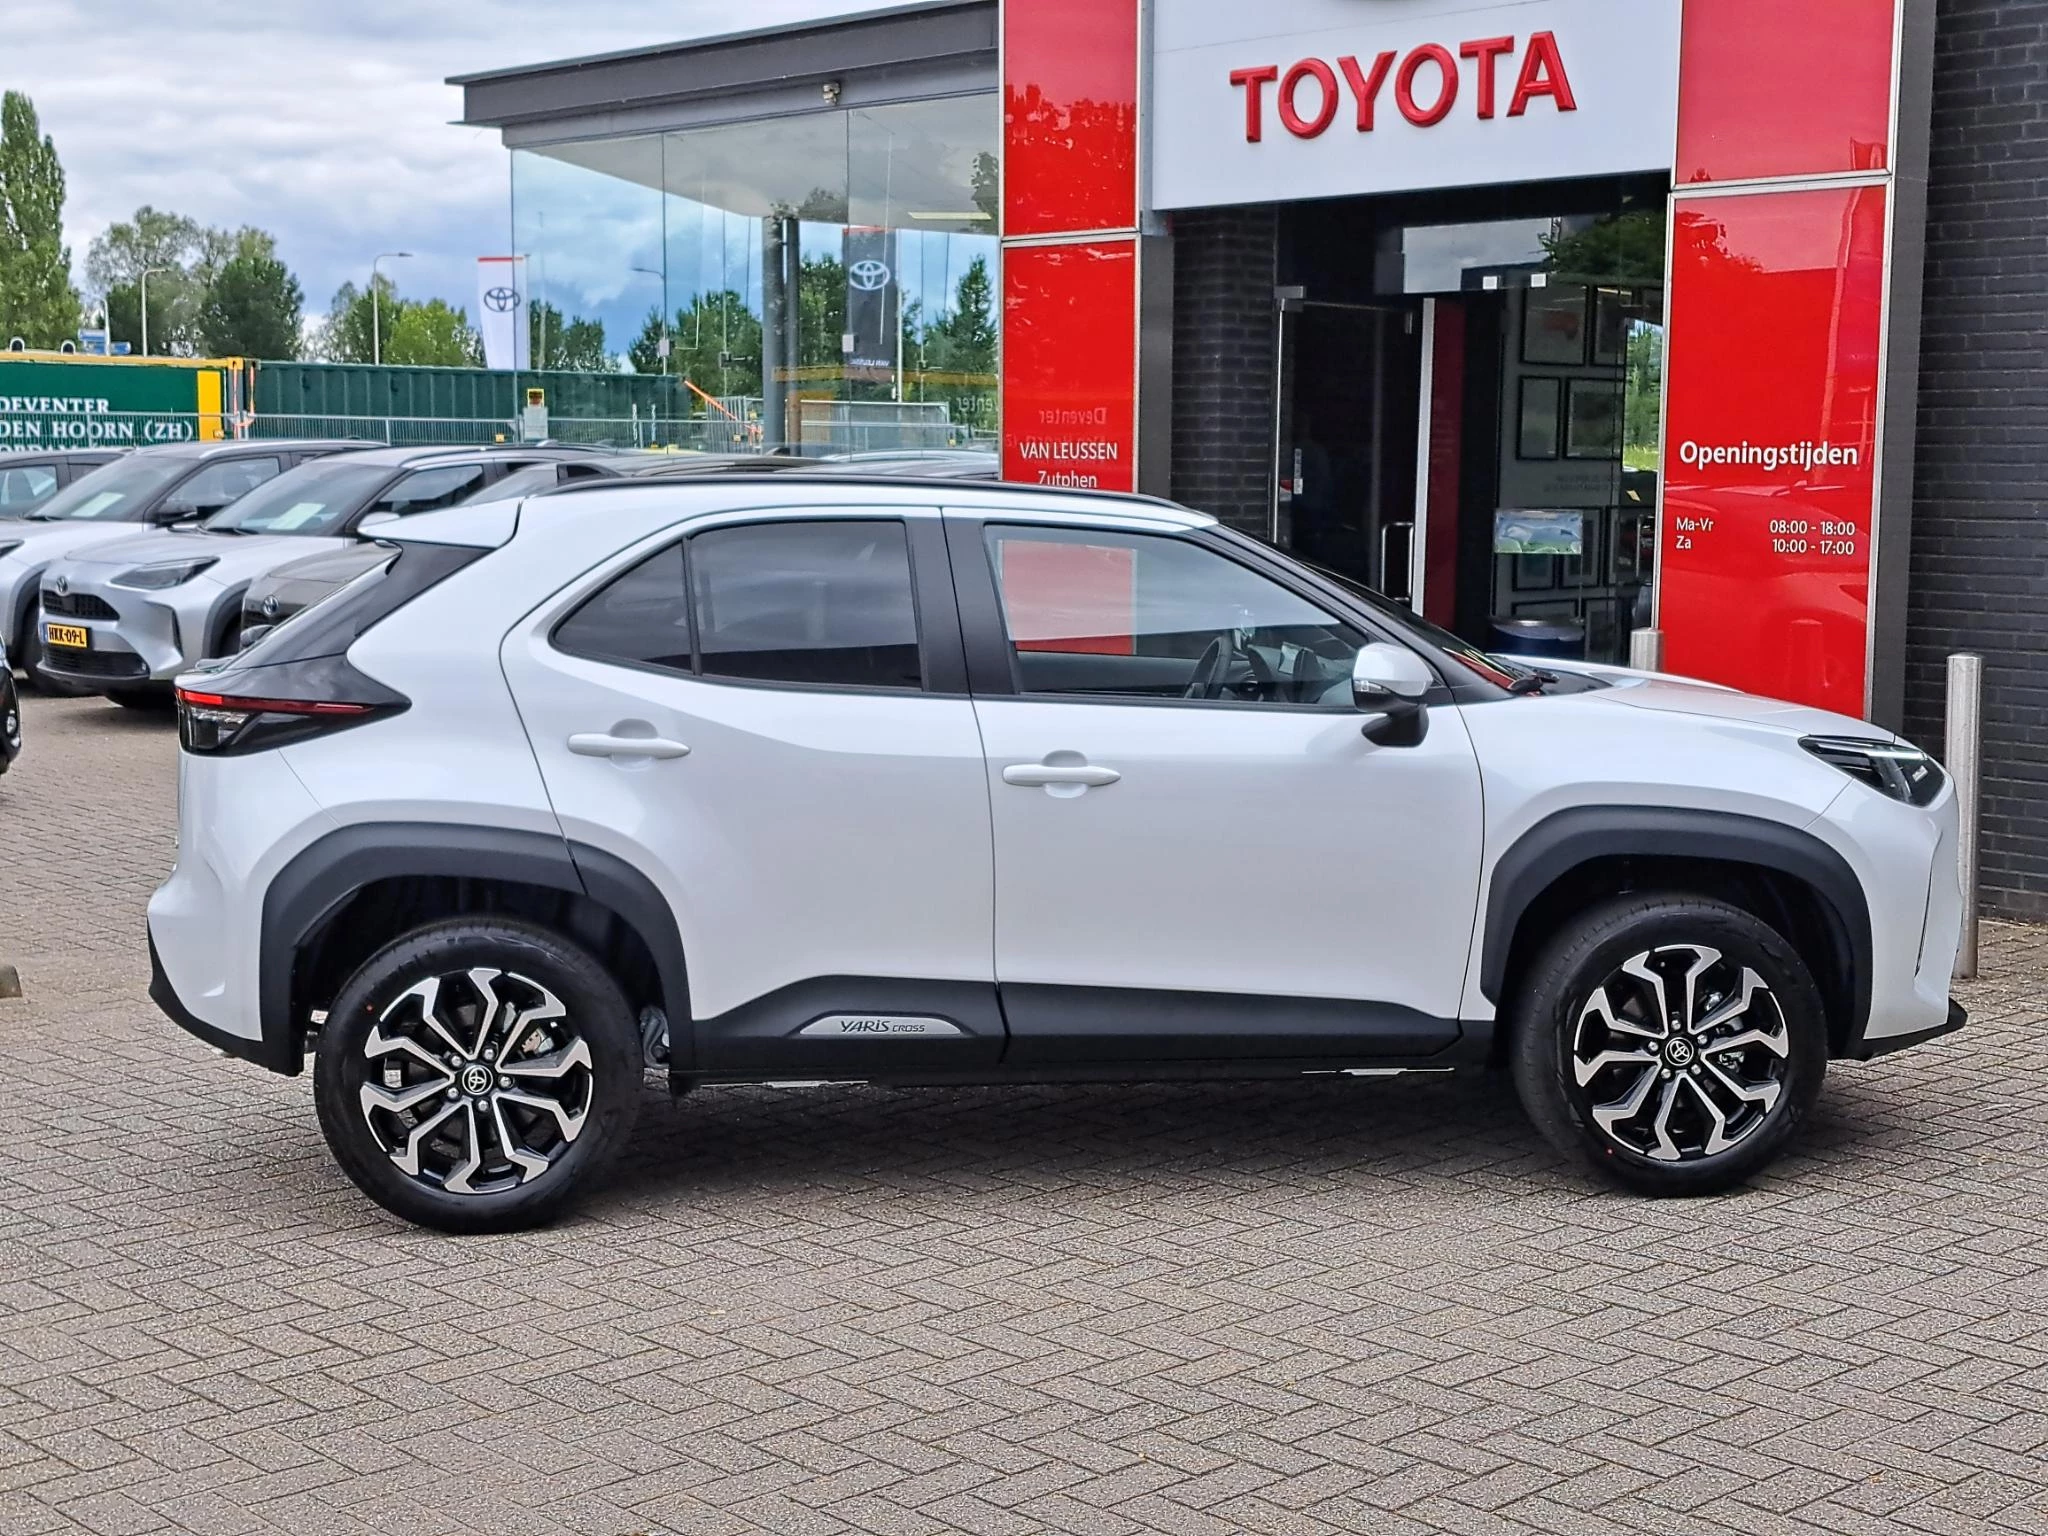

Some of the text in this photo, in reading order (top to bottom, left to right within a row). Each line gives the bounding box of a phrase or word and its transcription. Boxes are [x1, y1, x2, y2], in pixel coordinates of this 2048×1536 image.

[1229, 30, 1578, 143] TOYOTA
[53, 421, 134, 439] HOORN
[144, 419, 193, 442] (ZH)
[1020, 442, 1118, 460] VAN LEUSSEN
[1679, 441, 1858, 471] Openingstijden
[1038, 470, 1098, 488] Zutphen
[1676, 516, 1714, 532] Ma-Vr
[1769, 518, 1808, 534] 08:00
[1820, 520, 1855, 536] 18:00
[1675, 536, 1692, 550] Za
[1772, 538, 1808, 554] 10:00
[1820, 540, 1855, 555] 17:00
[892, 1024, 926, 1033] CROSS
